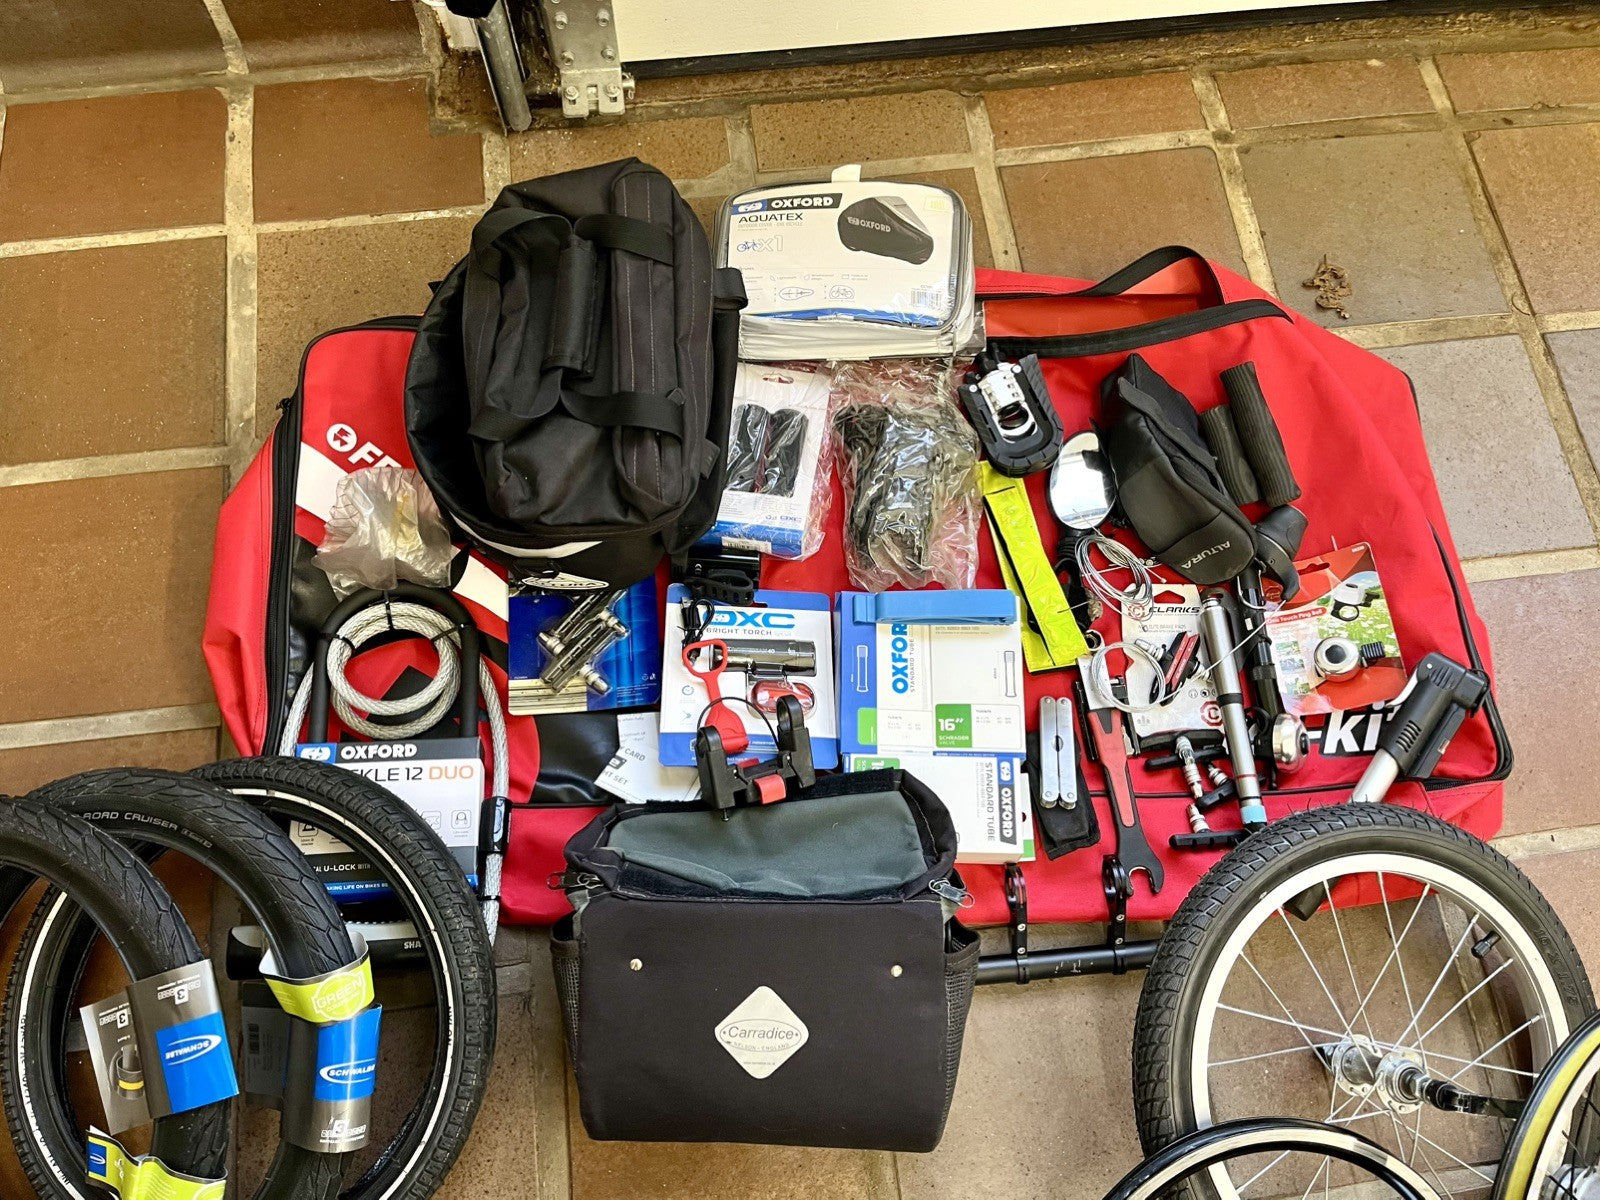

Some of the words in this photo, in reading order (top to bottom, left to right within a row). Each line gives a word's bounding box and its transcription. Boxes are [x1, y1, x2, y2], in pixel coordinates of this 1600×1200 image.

[771, 197, 834, 209] OXFORD
[738, 212, 804, 224] AQUATEX
[860, 219, 892, 233] OXFORD
[1181, 540, 1231, 569] ALTURA
[1148, 606, 1201, 614] CLARKS
[703, 610, 796, 629] OXC
[706, 627, 740, 635] BRIGHT
[742, 628, 773, 637] TORCH
[891, 623, 909, 695] OXFOR
[340, 744, 418, 760] OXFORD
[624, 747, 646, 762] CARD
[350, 767, 400, 782] KLE
[405, 766, 423, 780] 12
[428, 765, 474, 780] DUO
[613, 774, 628, 785] SET
[985, 761, 995, 814] STANDARD
[1001, 787, 1014, 838] OXFORD
[124, 812, 178, 831] CRUISER
[987, 815, 996, 842] TUBE
[323, 863, 356, 872] U-LOCK
[317, 977, 364, 1008] GREEN
[728, 1025, 794, 1040] Carradice
[165, 1040, 210, 1060] SCHWALBE
[761, 1042, 790, 1051] ENGLAND
[328, 1064, 376, 1077] SCHWALBE
